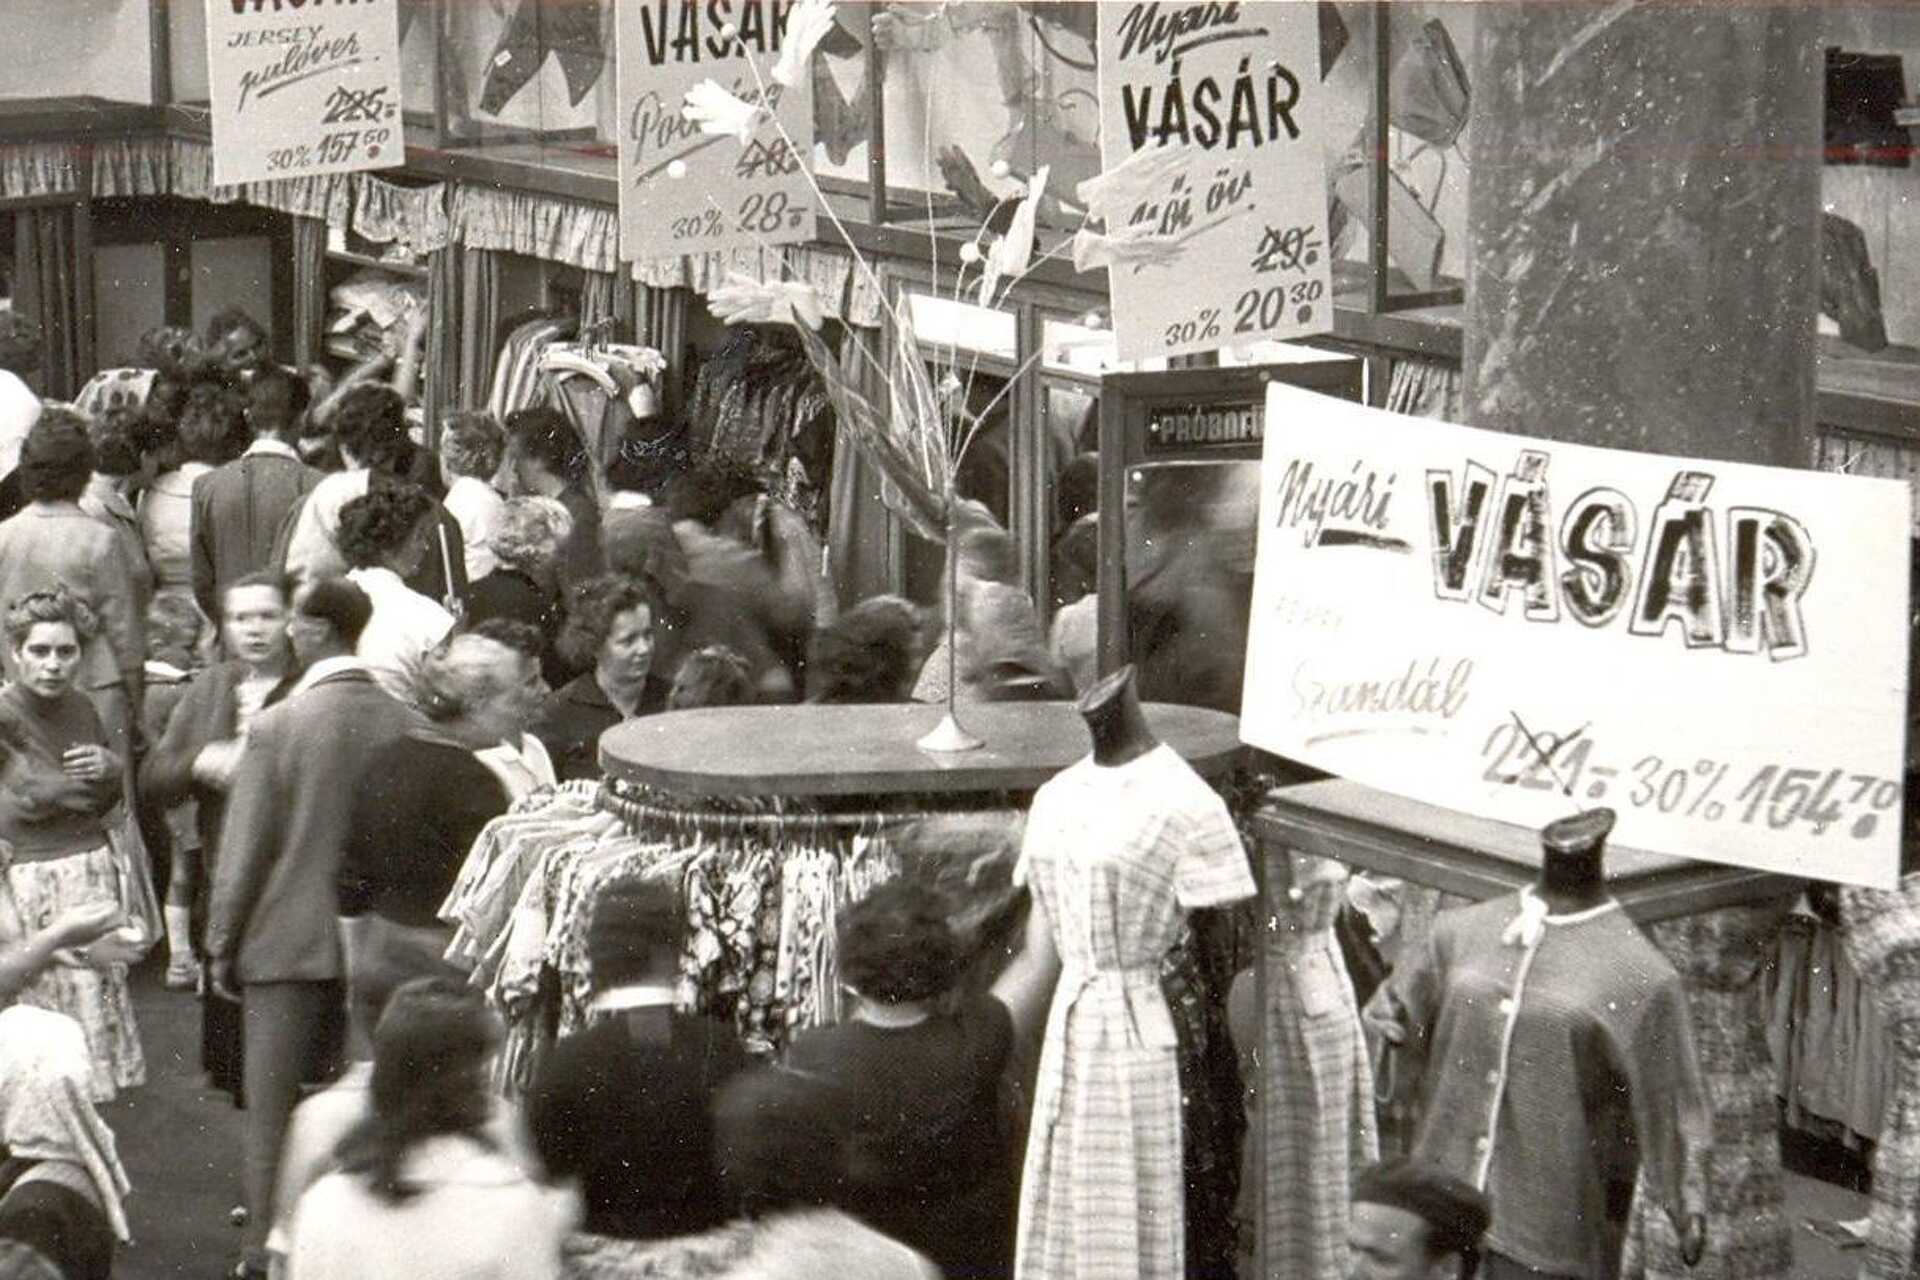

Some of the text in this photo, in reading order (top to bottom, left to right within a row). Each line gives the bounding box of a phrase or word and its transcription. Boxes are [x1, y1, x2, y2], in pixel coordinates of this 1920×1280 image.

[228, 25, 323, 48] JERSEY
[1122, 58, 1300, 151] VÁSÁR
[267, 145, 310, 171] 30%
[671, 208, 724, 240] 30%
[1165, 309, 1221, 347] 30%
[1276, 450, 1818, 662] Nyári VÁSÁR
[1290, 656, 1475, 720] Szandál
[1628, 753, 1730, 822] 30%
